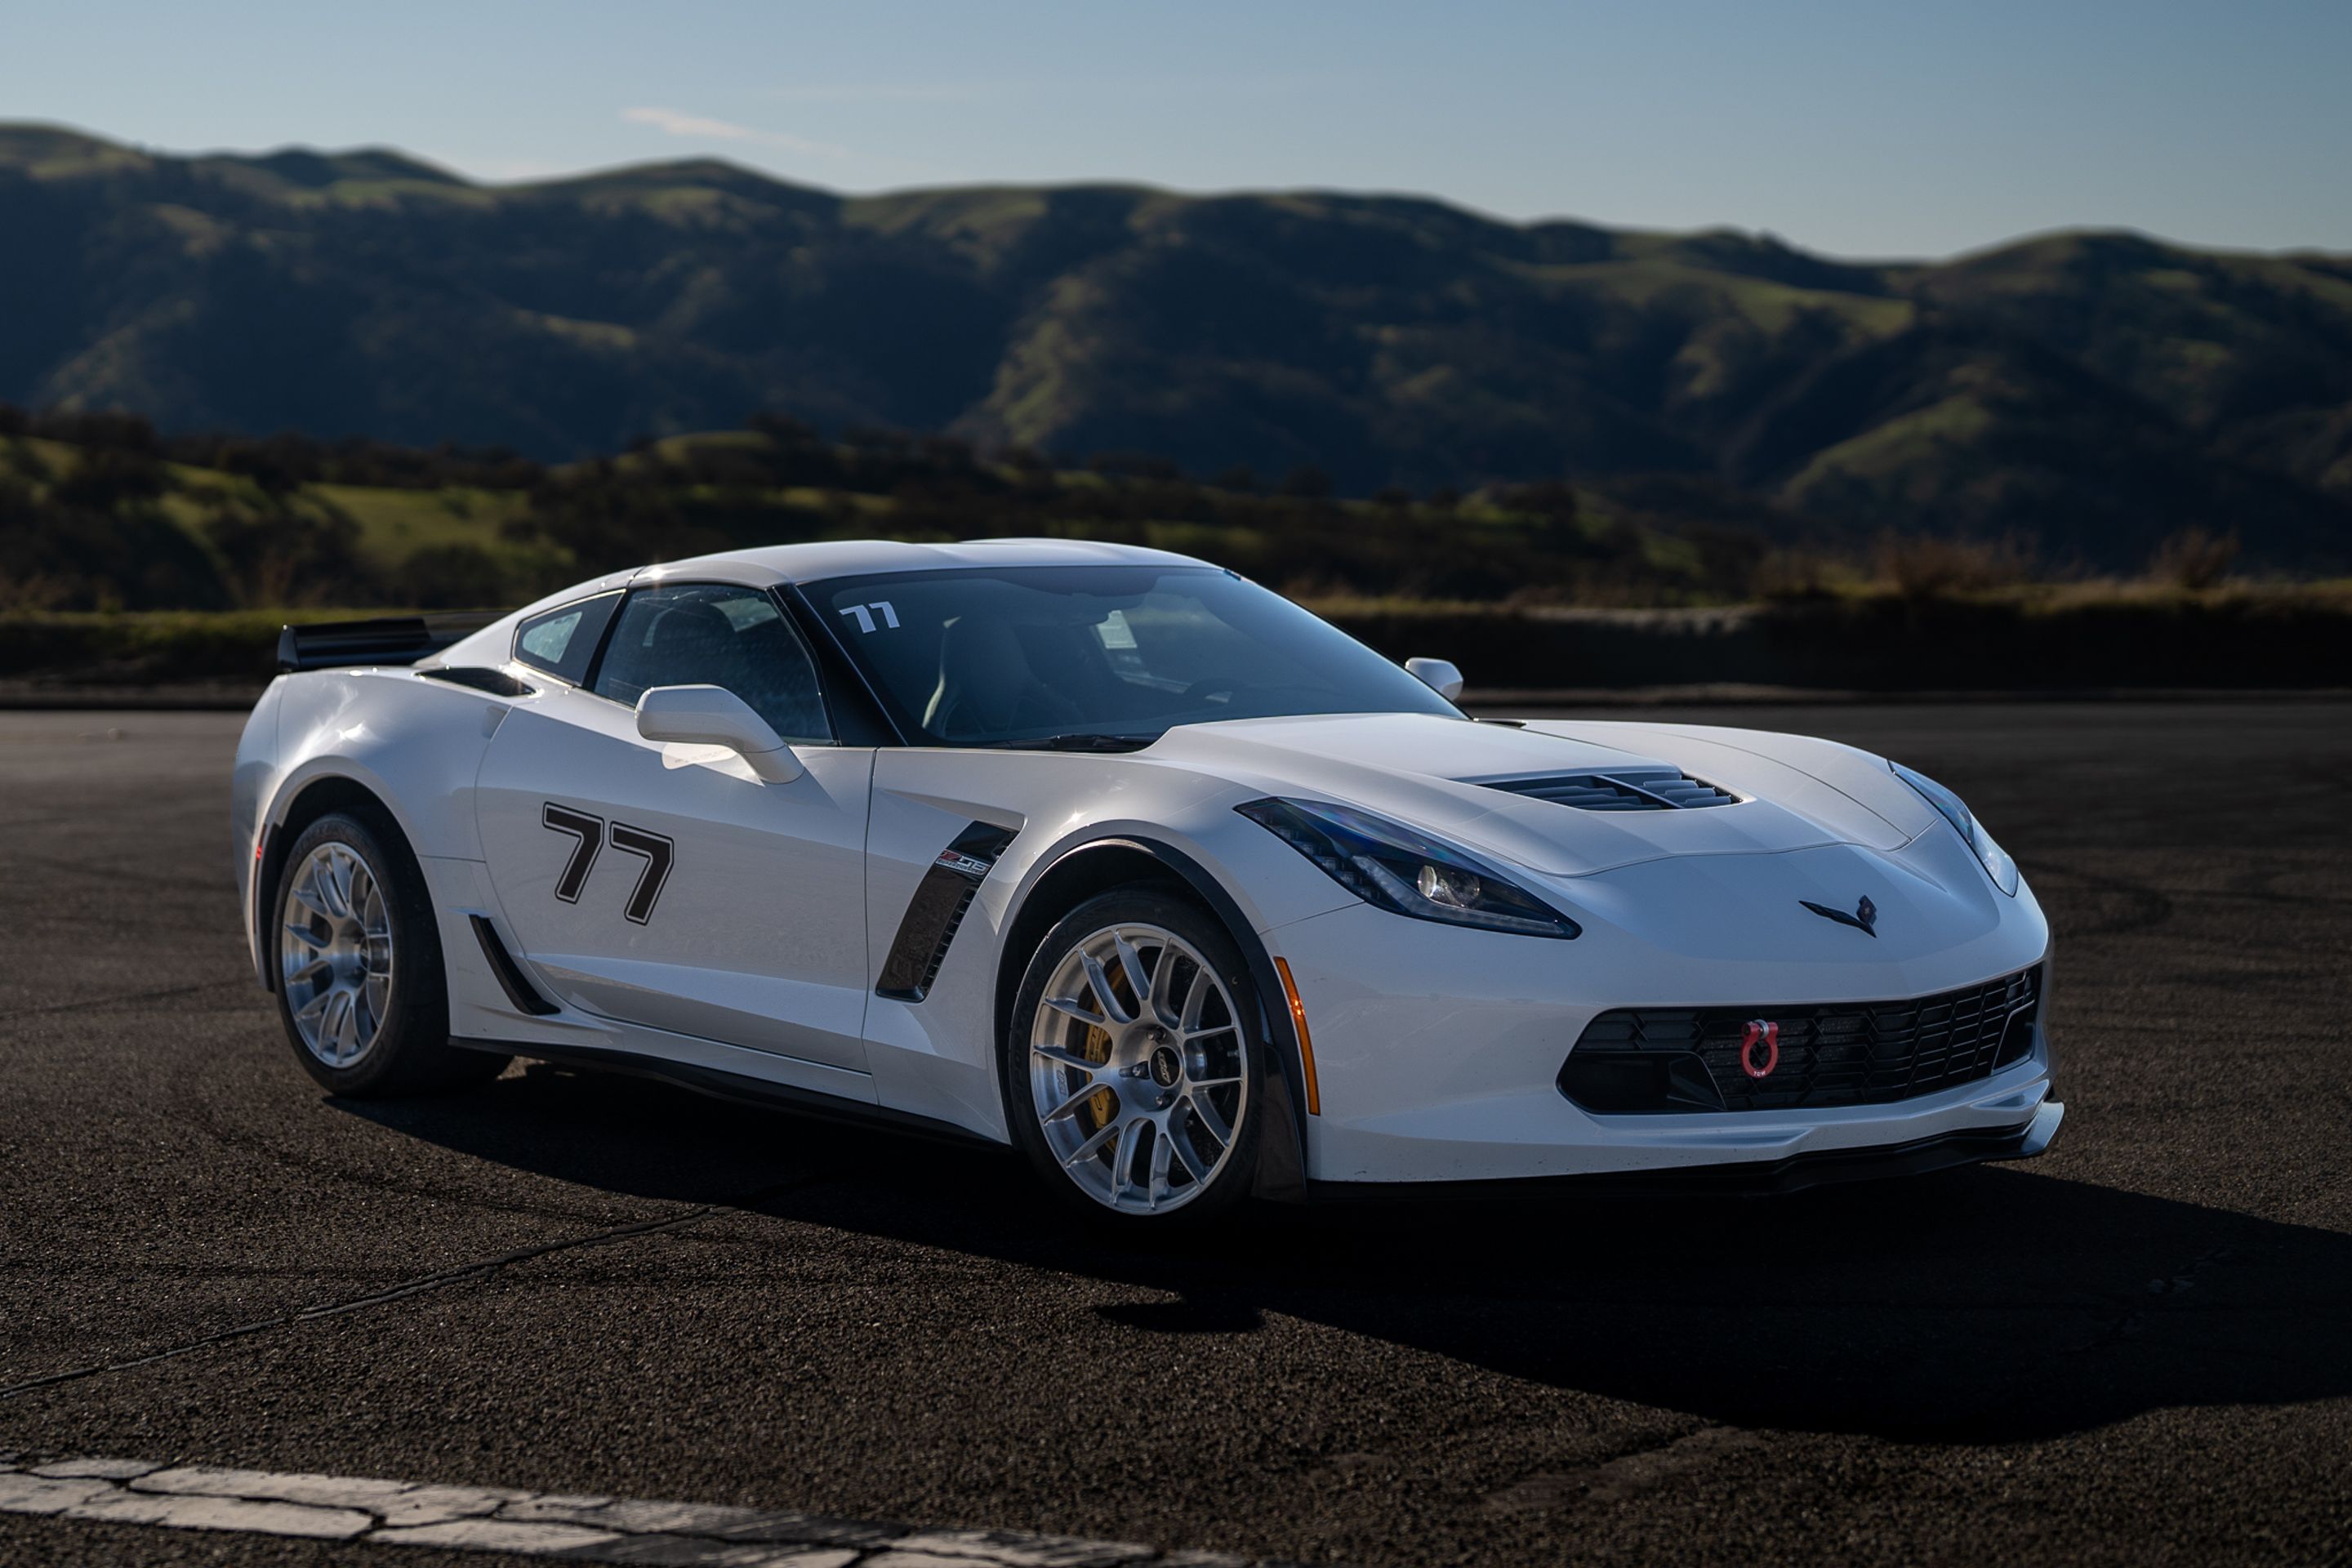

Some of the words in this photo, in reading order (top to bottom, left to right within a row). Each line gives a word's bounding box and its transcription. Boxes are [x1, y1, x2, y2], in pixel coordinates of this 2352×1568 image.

[839, 601, 900, 634] 77
[542, 801, 675, 926] 77
[1753, 1070, 1766, 1078] TOW
